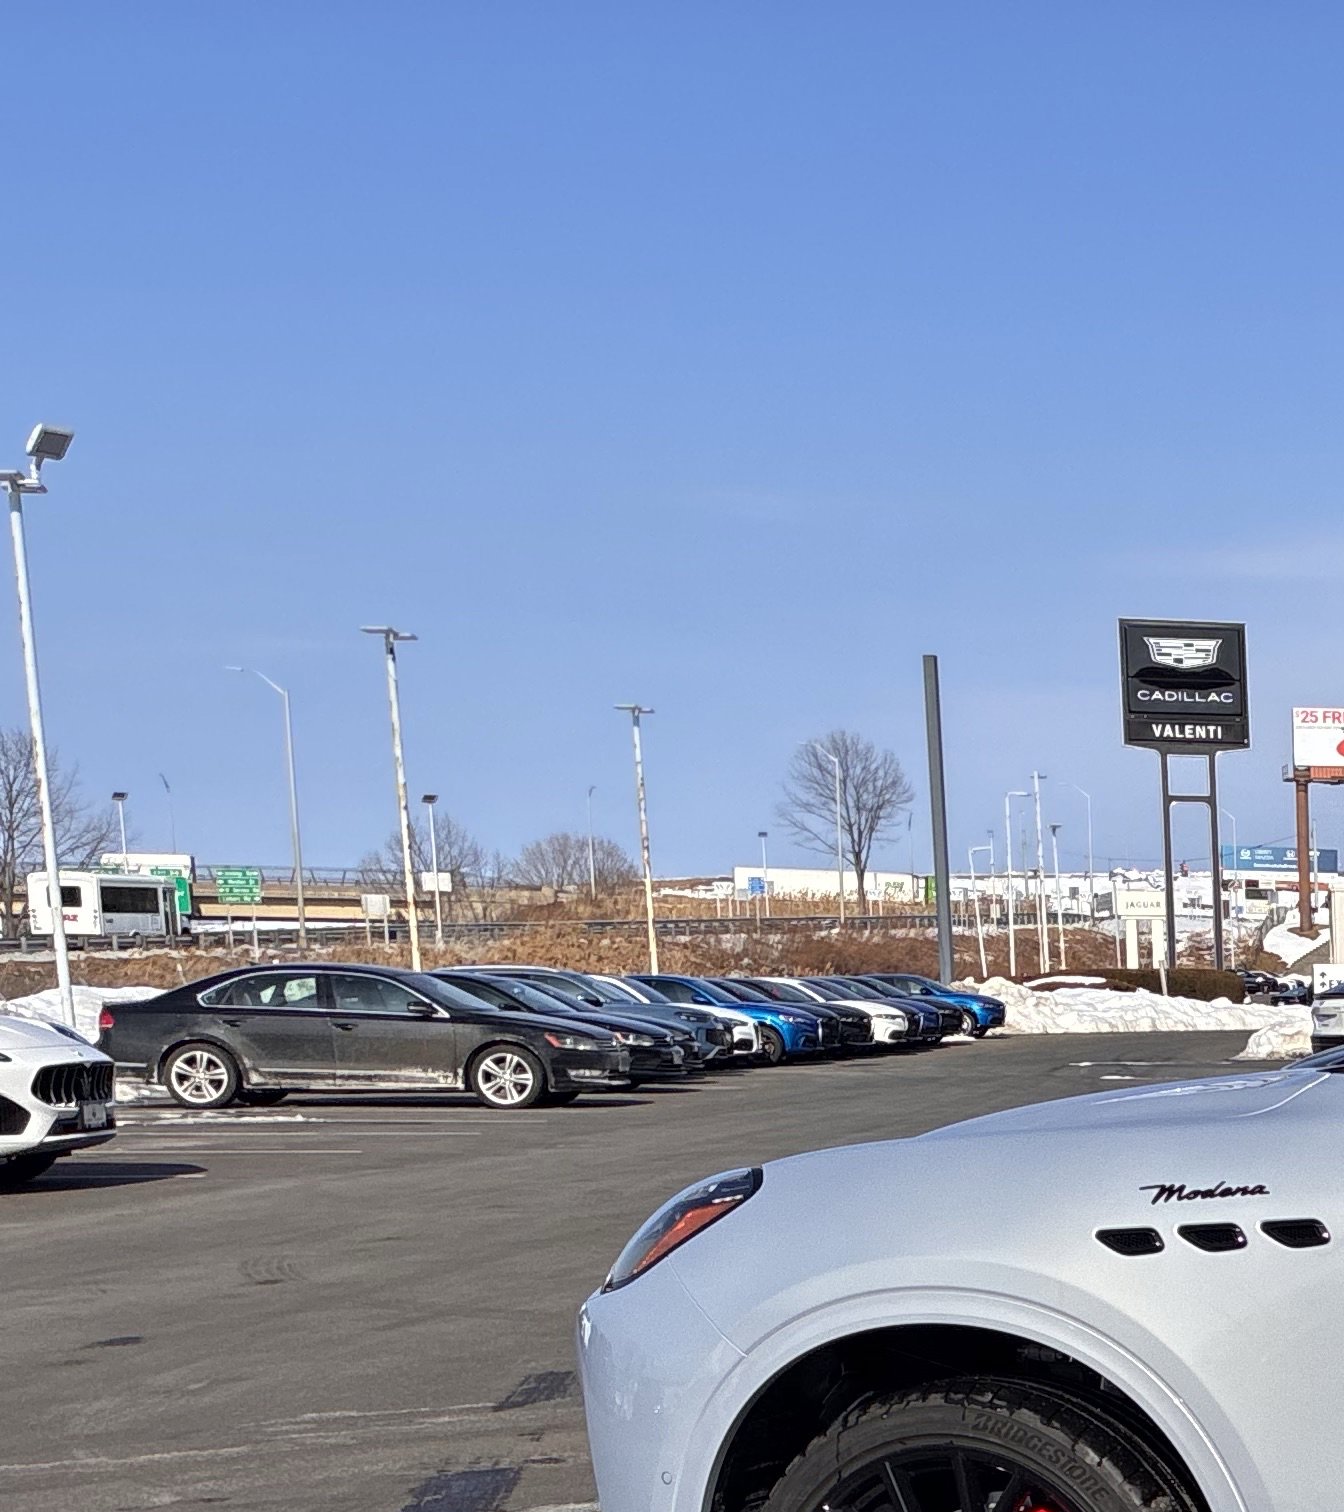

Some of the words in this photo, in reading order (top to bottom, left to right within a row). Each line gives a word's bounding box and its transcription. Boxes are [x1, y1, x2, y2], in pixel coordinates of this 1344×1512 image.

[1136, 689, 1234, 703] CADILLAC
[1151, 723, 1223, 739] VALENTI
[1126, 901, 1161, 909] JAGUAR
[1139, 1180, 1270, 1205] Modena
[971, 1413, 1110, 1500] BRIDGESTONE
